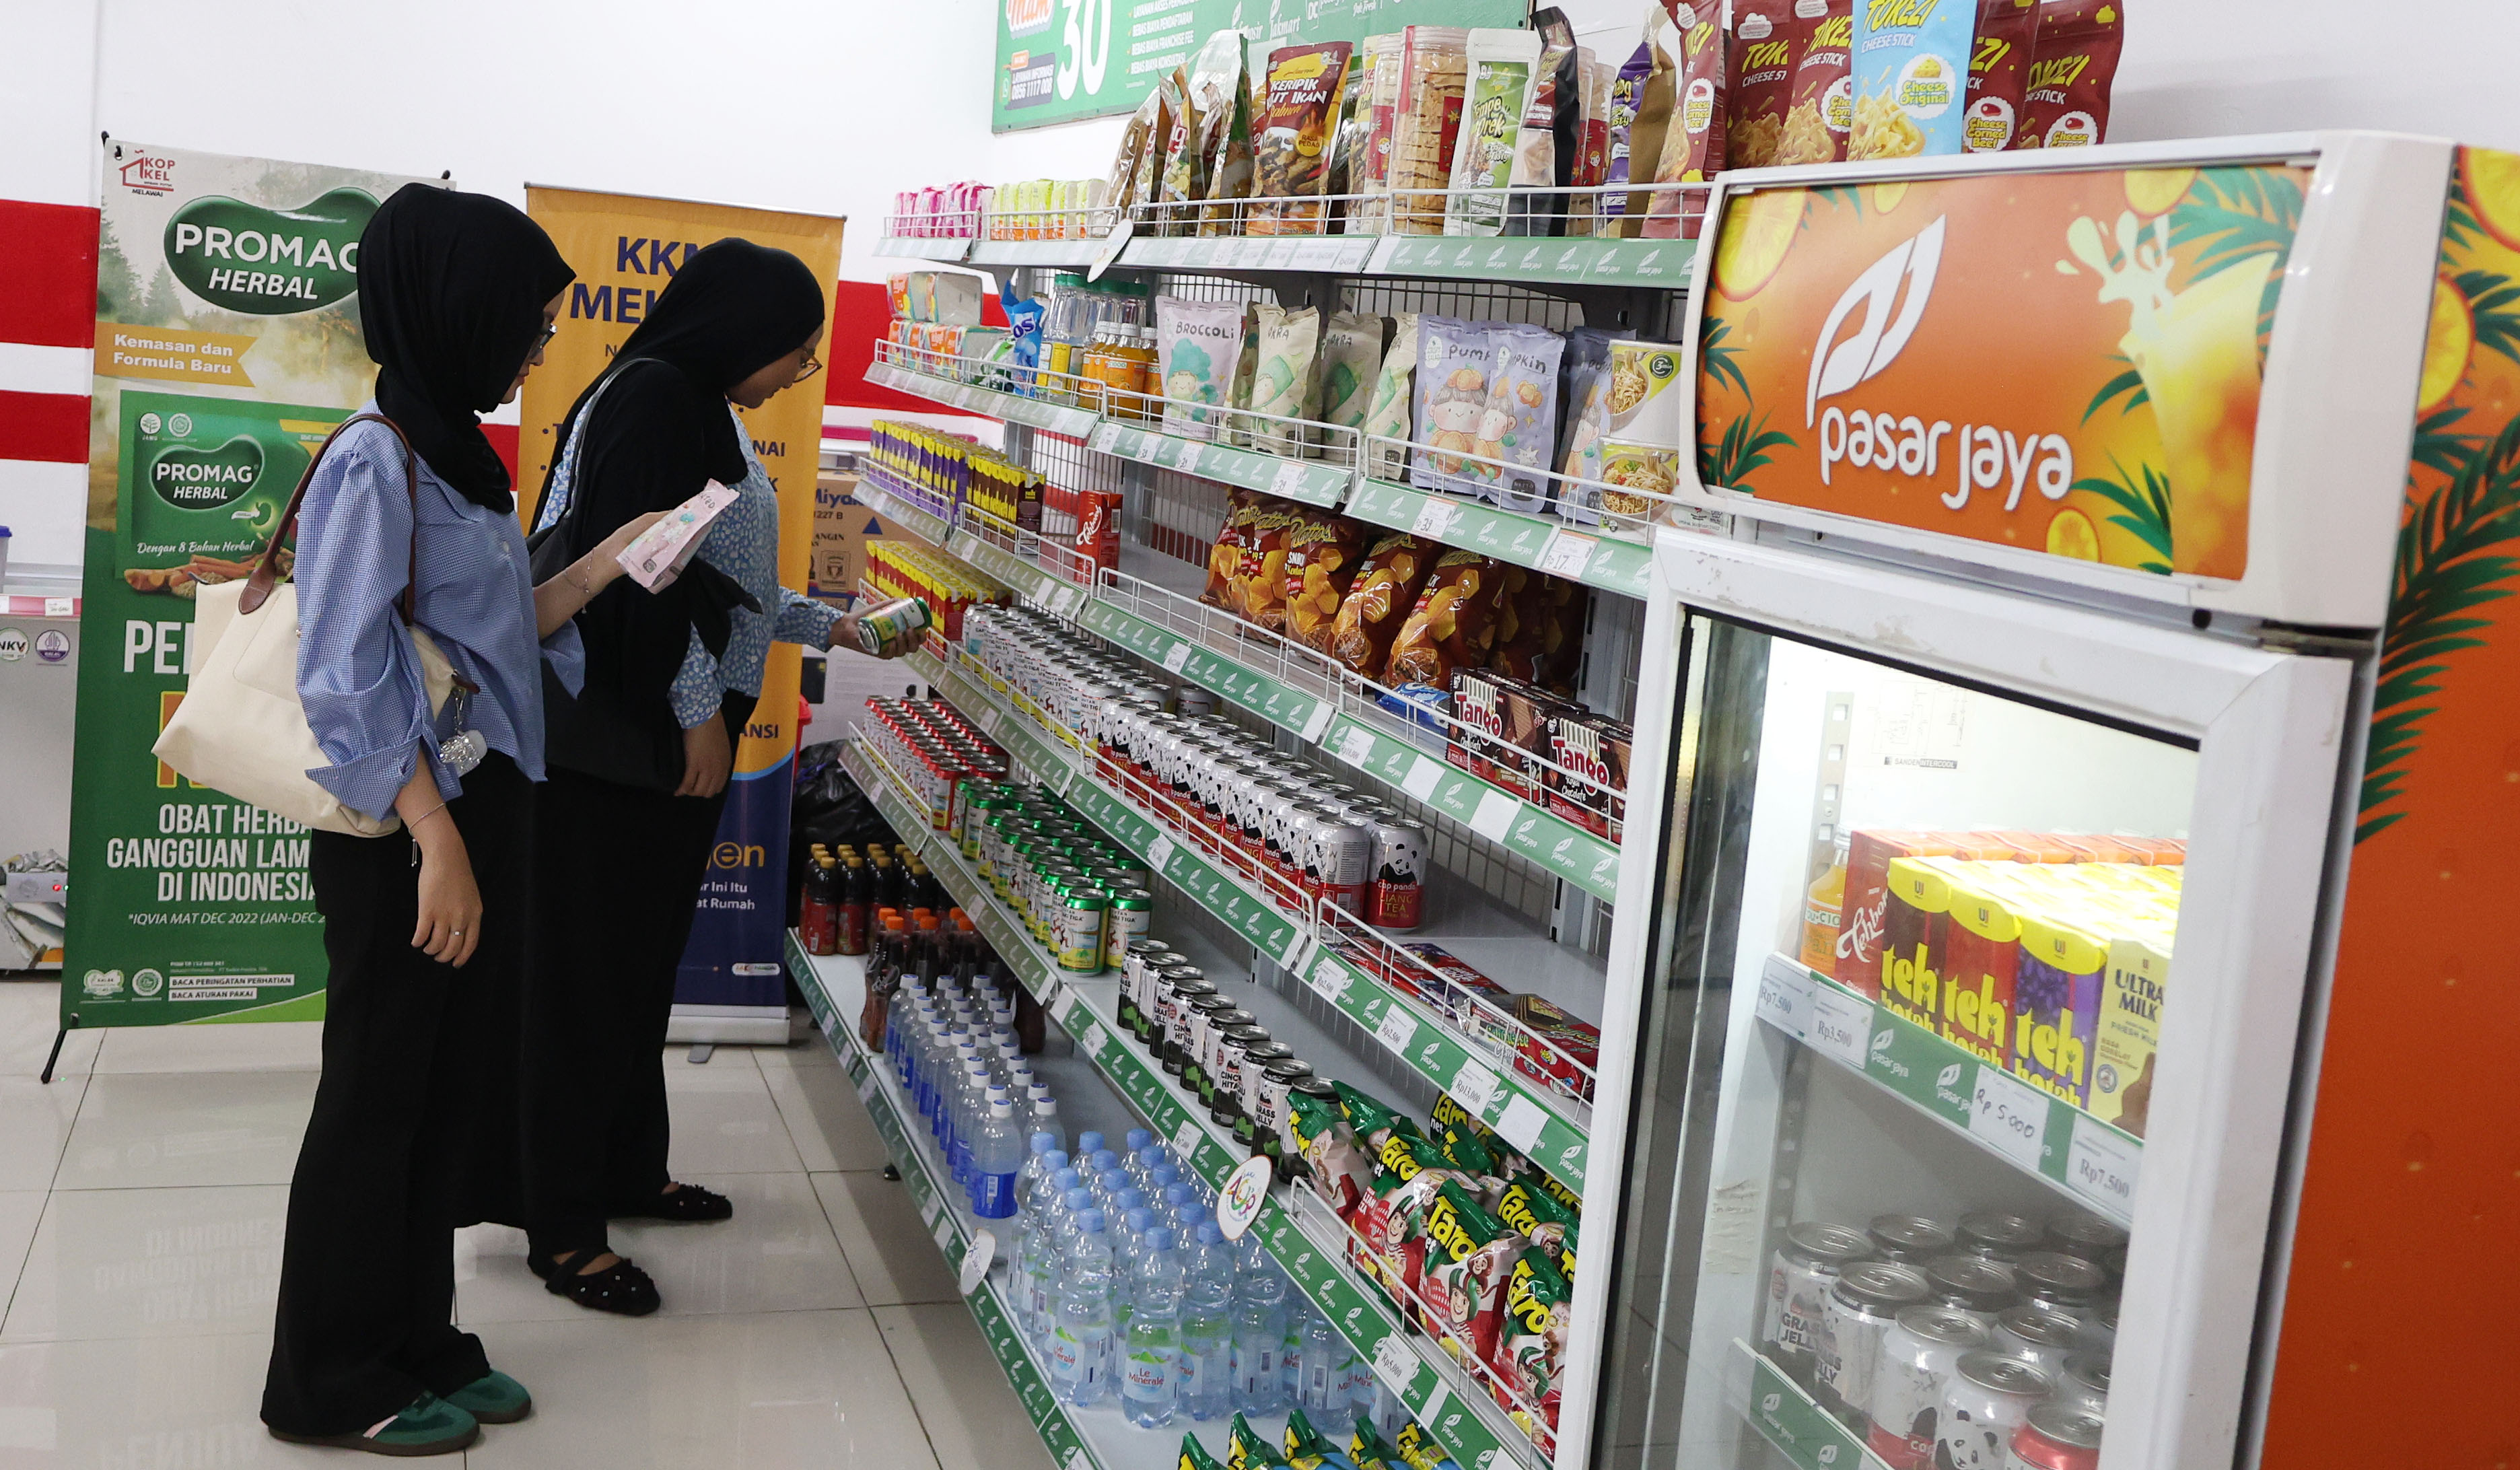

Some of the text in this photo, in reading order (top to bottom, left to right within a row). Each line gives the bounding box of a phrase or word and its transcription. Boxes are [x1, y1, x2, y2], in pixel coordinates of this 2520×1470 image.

[1861, 33, 1918, 54] CHEESE STICK
[1821, 53, 1847, 67] STICK
[1270, 79, 1319, 92] KERIPIK
[1902, 80, 1947, 92] Cheese
[1292, 91, 1327, 104] IKAN
[1899, 91, 1950, 107] Original
[1968, 118, 2007, 128] Cheese
[1967, 127, 2006, 139] Corned
[1972, 138, 1998, 149] Beef
[145, 157, 175, 169] KOP
[144, 169, 170, 181] KEL
[209, 268, 318, 301] HERBAL
[114, 333, 234, 357] Kemasan dan
[113, 352, 232, 374] Formula Baru
[1821, 406, 2074, 512] pasar jaya
[157, 462, 253, 483] PROMAG
[174, 486, 228, 499] HERBAL
[137, 542, 176, 557] Dengan
[189, 541, 220, 553] Bahan
[222, 540, 255, 553] Herbal
[1455, 691, 1502, 746] Tango
[1551, 736, 1609, 796] Tango
[159, 804, 228, 835] OBAT
[106, 838, 248, 868] GANGGUAN
[158, 872, 182, 901] DI
[711, 881, 748, 893] Ini Itu
[1378, 882, 1416, 892] cap panda
[711, 898, 755, 910] Rumah
[1386, 903, 1406, 912] TEA
[170, 913, 197, 924] MAT
[201, 913, 227, 924] DEC
[229, 913, 258, 925] 2022
[172, 978, 193, 986] BACA
[1881, 943, 1939, 1012] teh
[172, 991, 192, 1000] BACA
[1945, 974, 2007, 1047] teh
[2119, 992, 2157, 1024] MILK
[2017, 1006, 2085, 1086] teh
[1427, 1195, 1479, 1263] Taro
[1128, 1370, 1164, 1387] Minerale
[1140, 1366, 1150, 1378] Le
